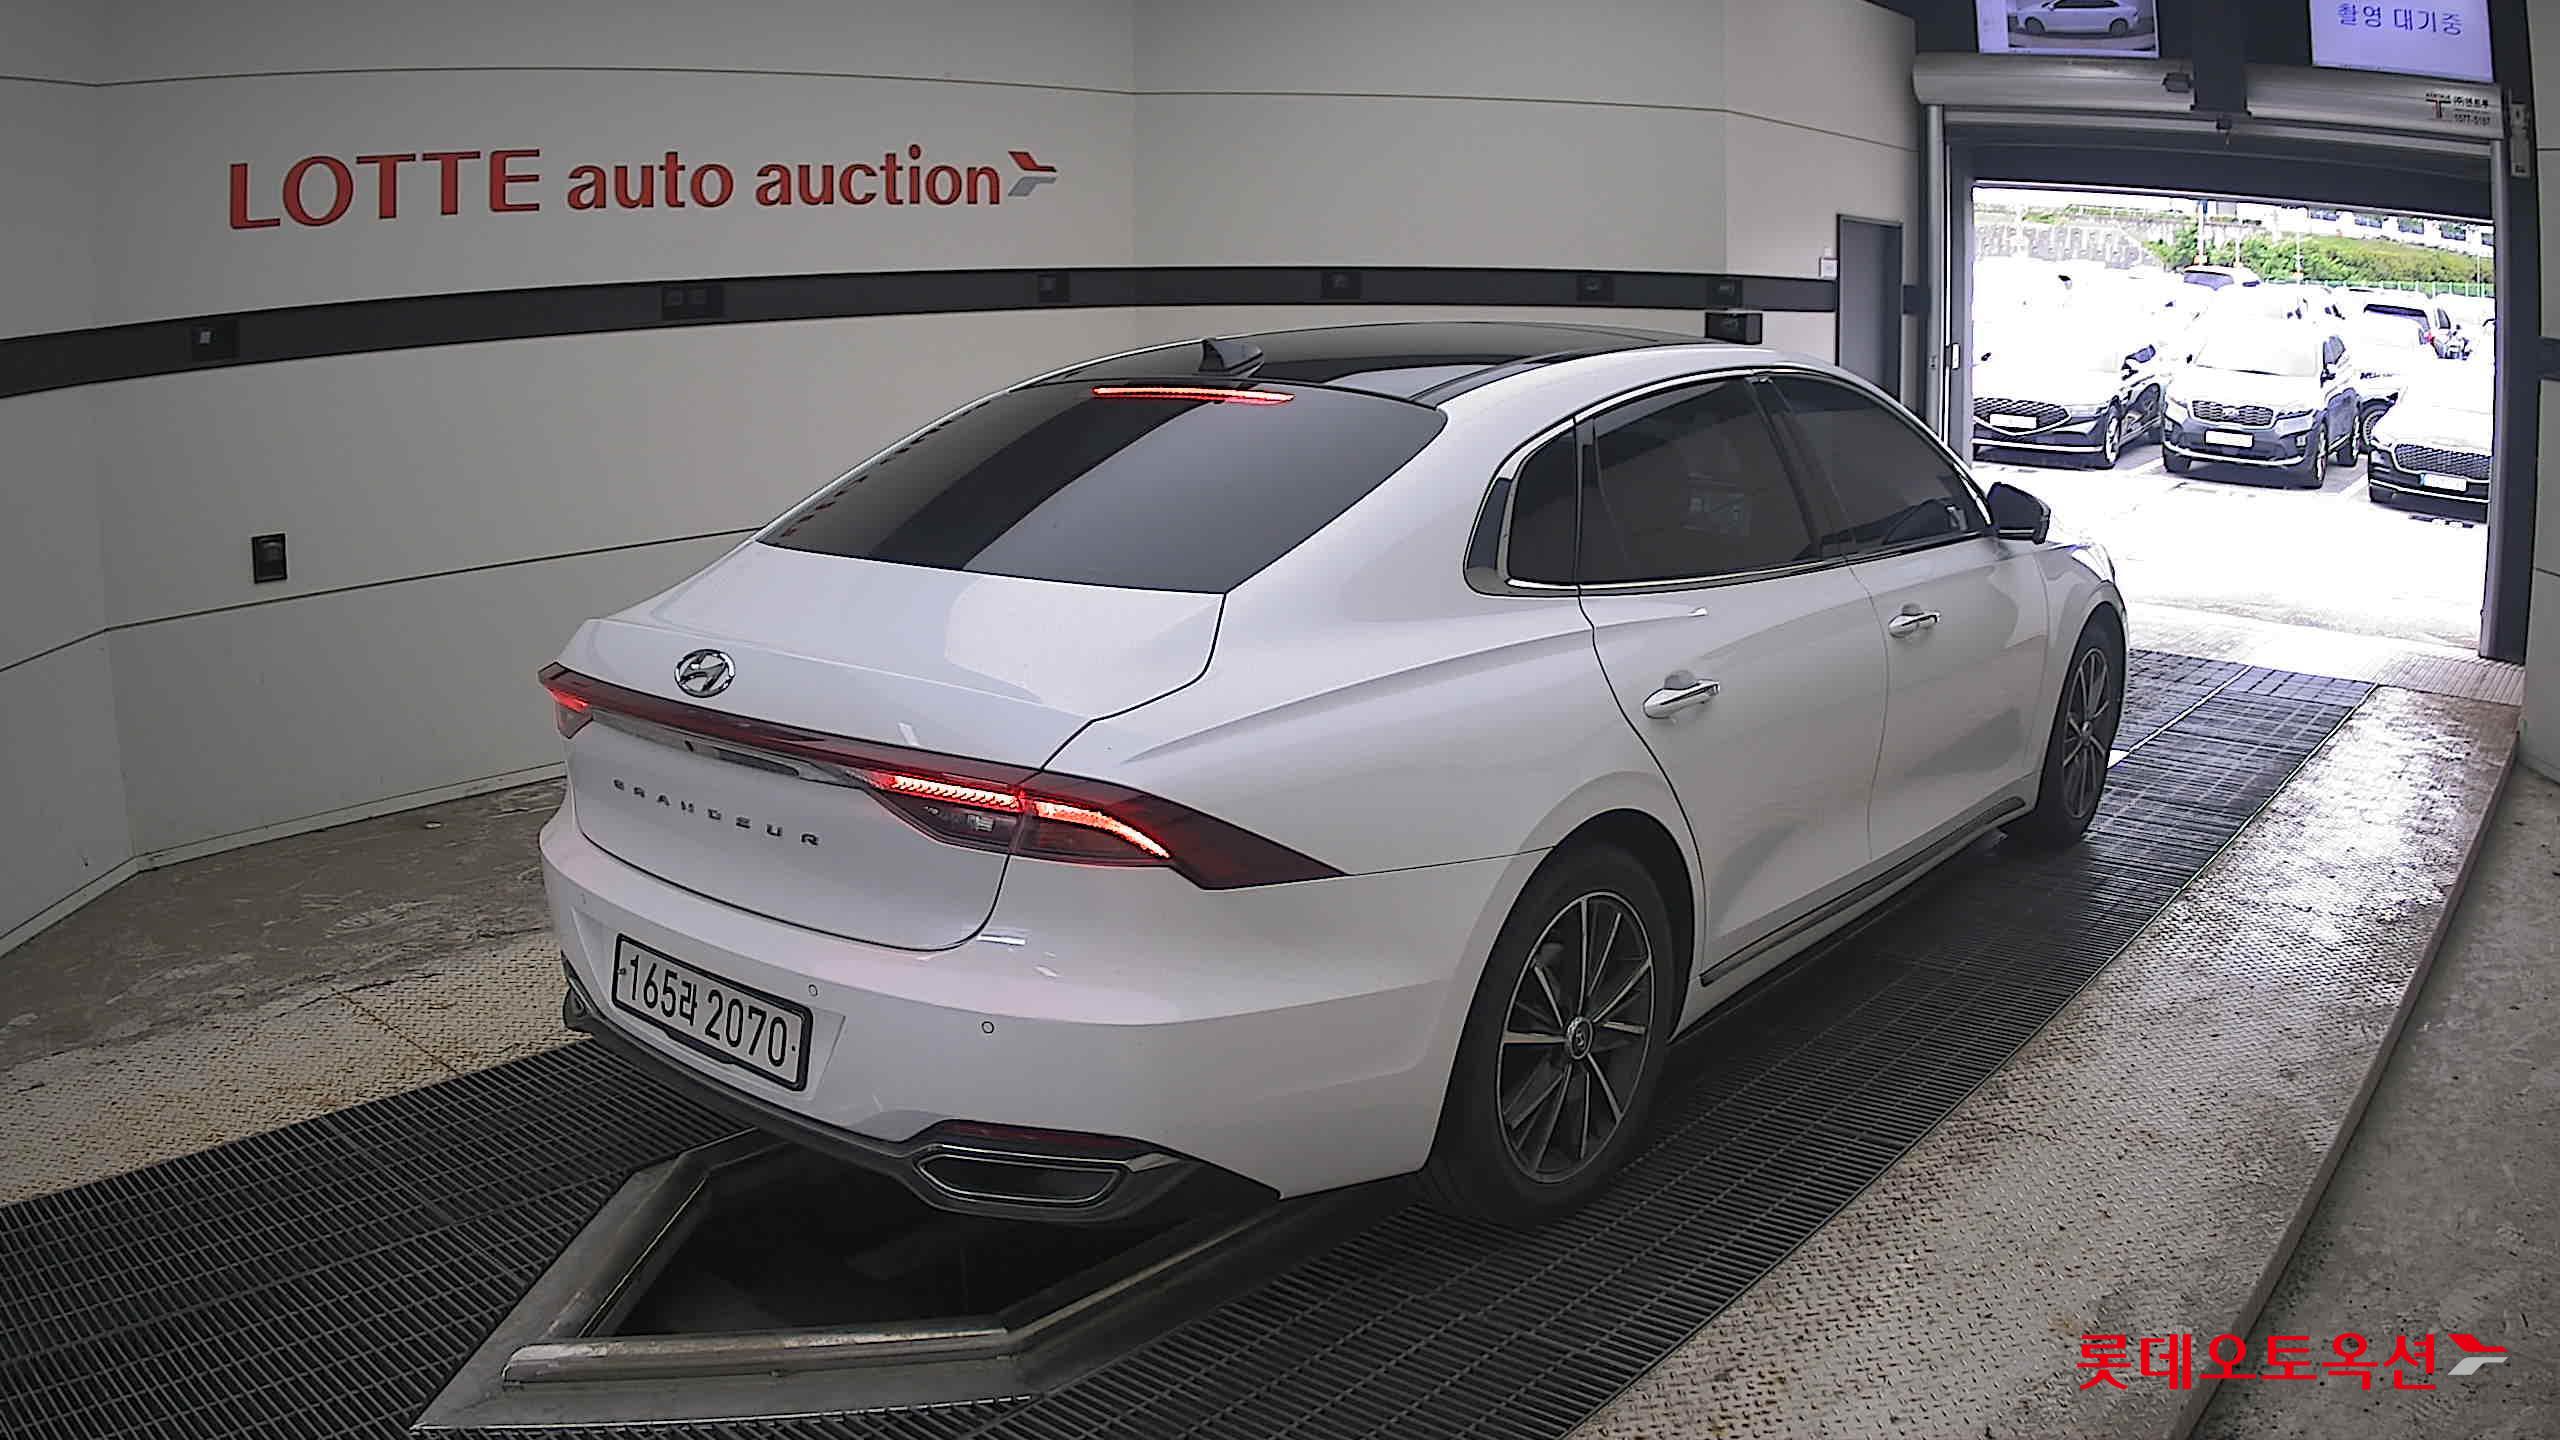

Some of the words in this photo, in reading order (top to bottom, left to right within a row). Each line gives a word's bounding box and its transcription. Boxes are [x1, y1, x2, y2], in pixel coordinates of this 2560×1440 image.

[2338, 3, 2382, 28] 촬영
[2393, 8, 2463, 36] 대기중
[230, 150, 540, 230] LOTTE
[567, 150, 735, 210] auto
[755, 144, 1003, 206] auction
[629, 953, 698, 1026] 165라
[704, 988, 788, 1068] 2070
